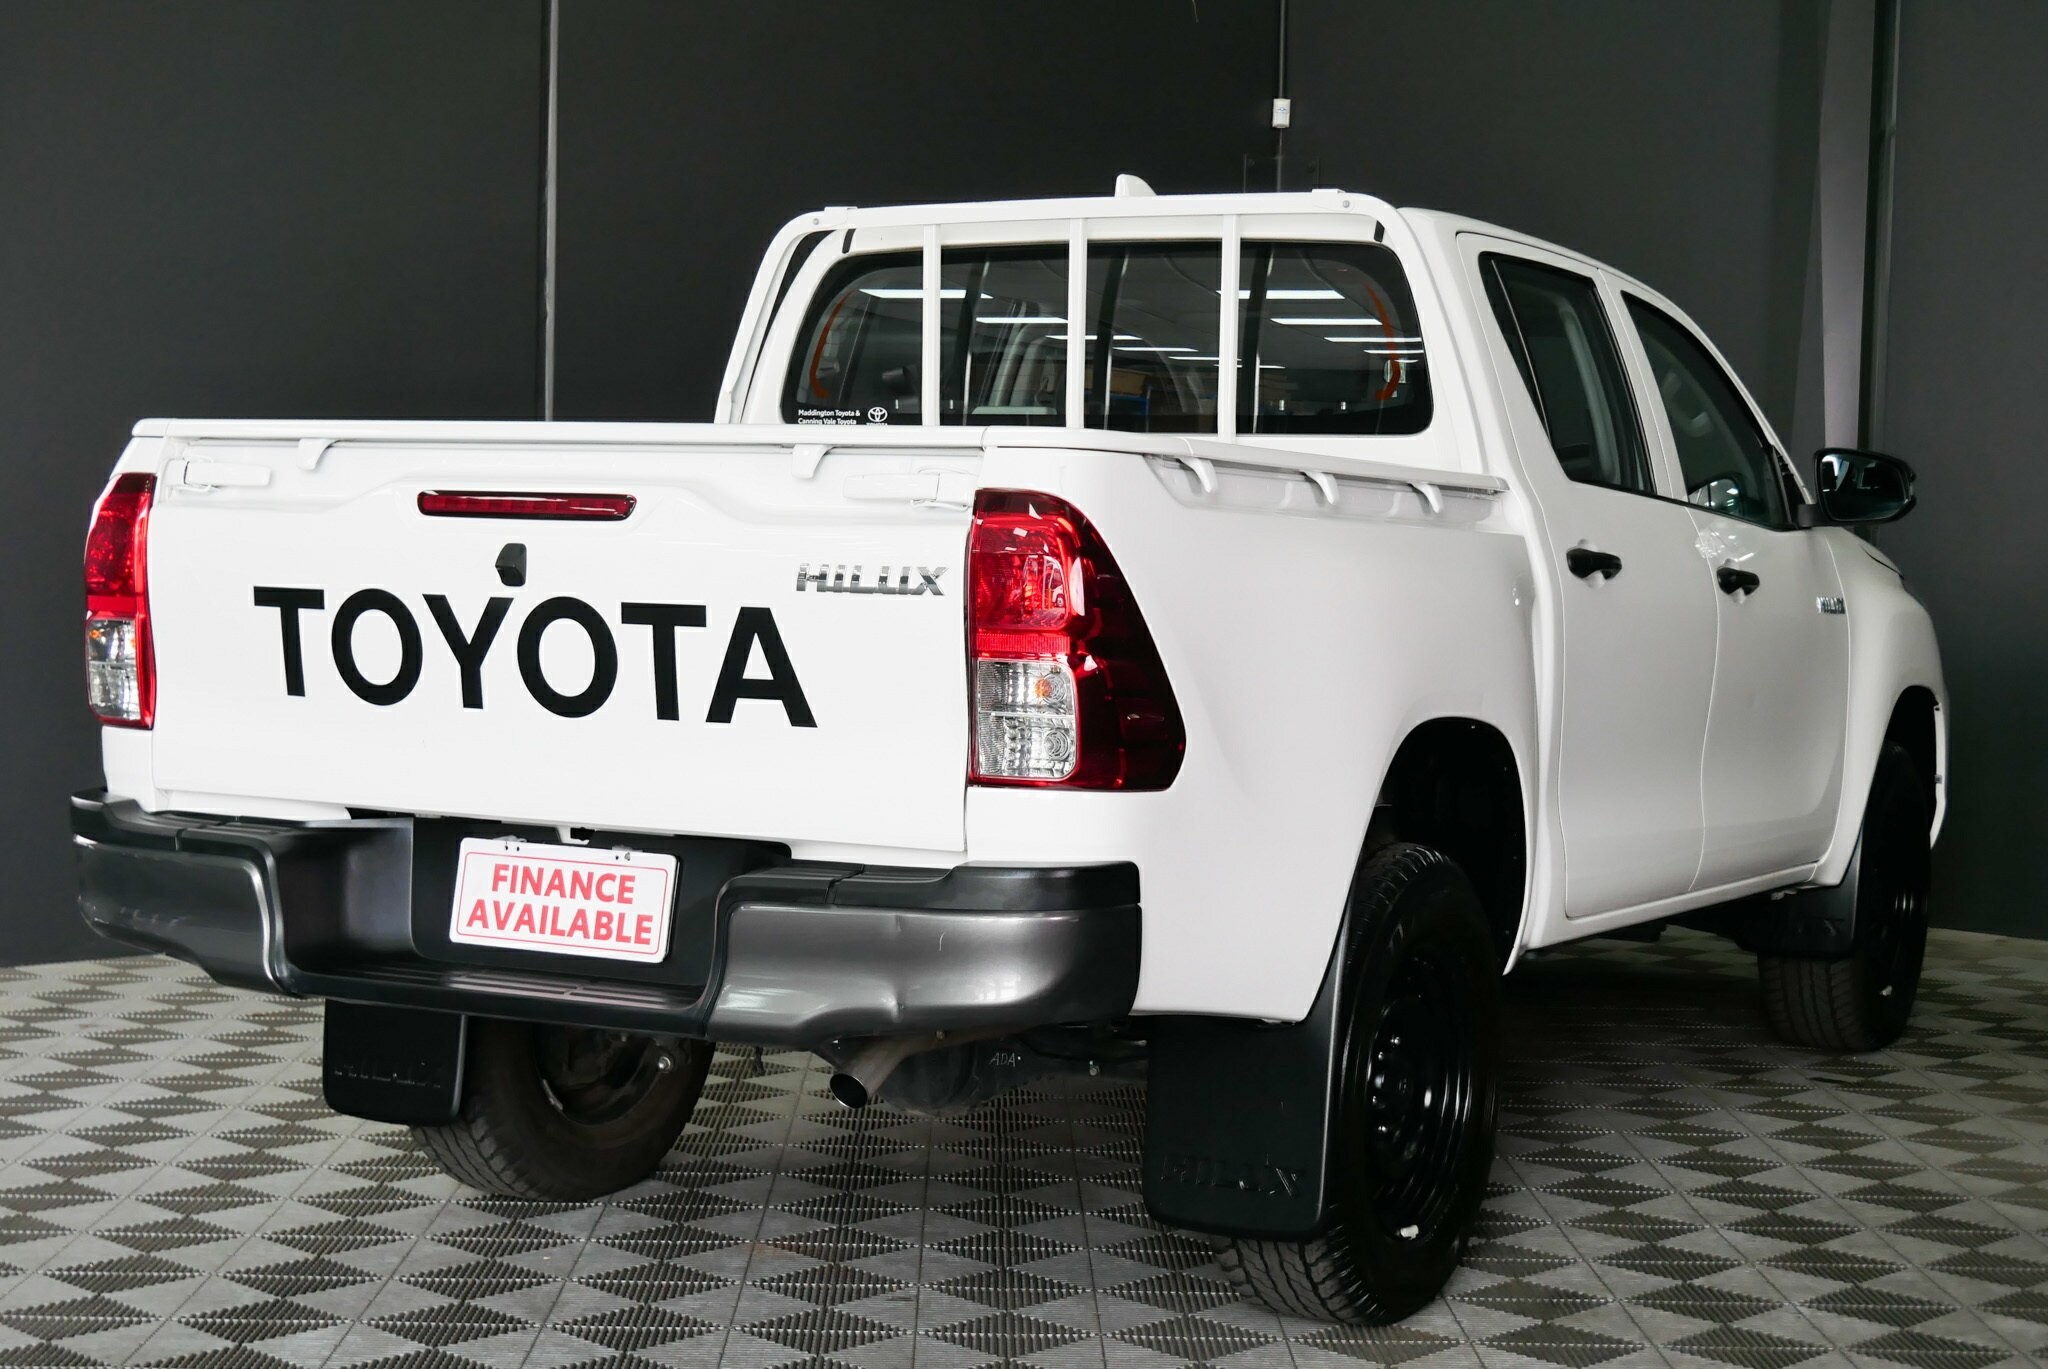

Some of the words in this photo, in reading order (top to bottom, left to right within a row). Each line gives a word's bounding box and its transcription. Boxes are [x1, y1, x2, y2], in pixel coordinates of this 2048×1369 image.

[798, 409, 834, 417] Maddington
[835, 410, 855, 418] Toyota
[855, 409, 861, 417] &
[796, 563, 946, 596] HILUX
[254, 587, 817, 727] TOYOTA
[491, 863, 636, 905] FINANCE
[466, 899, 653, 945] AVAILABLE
